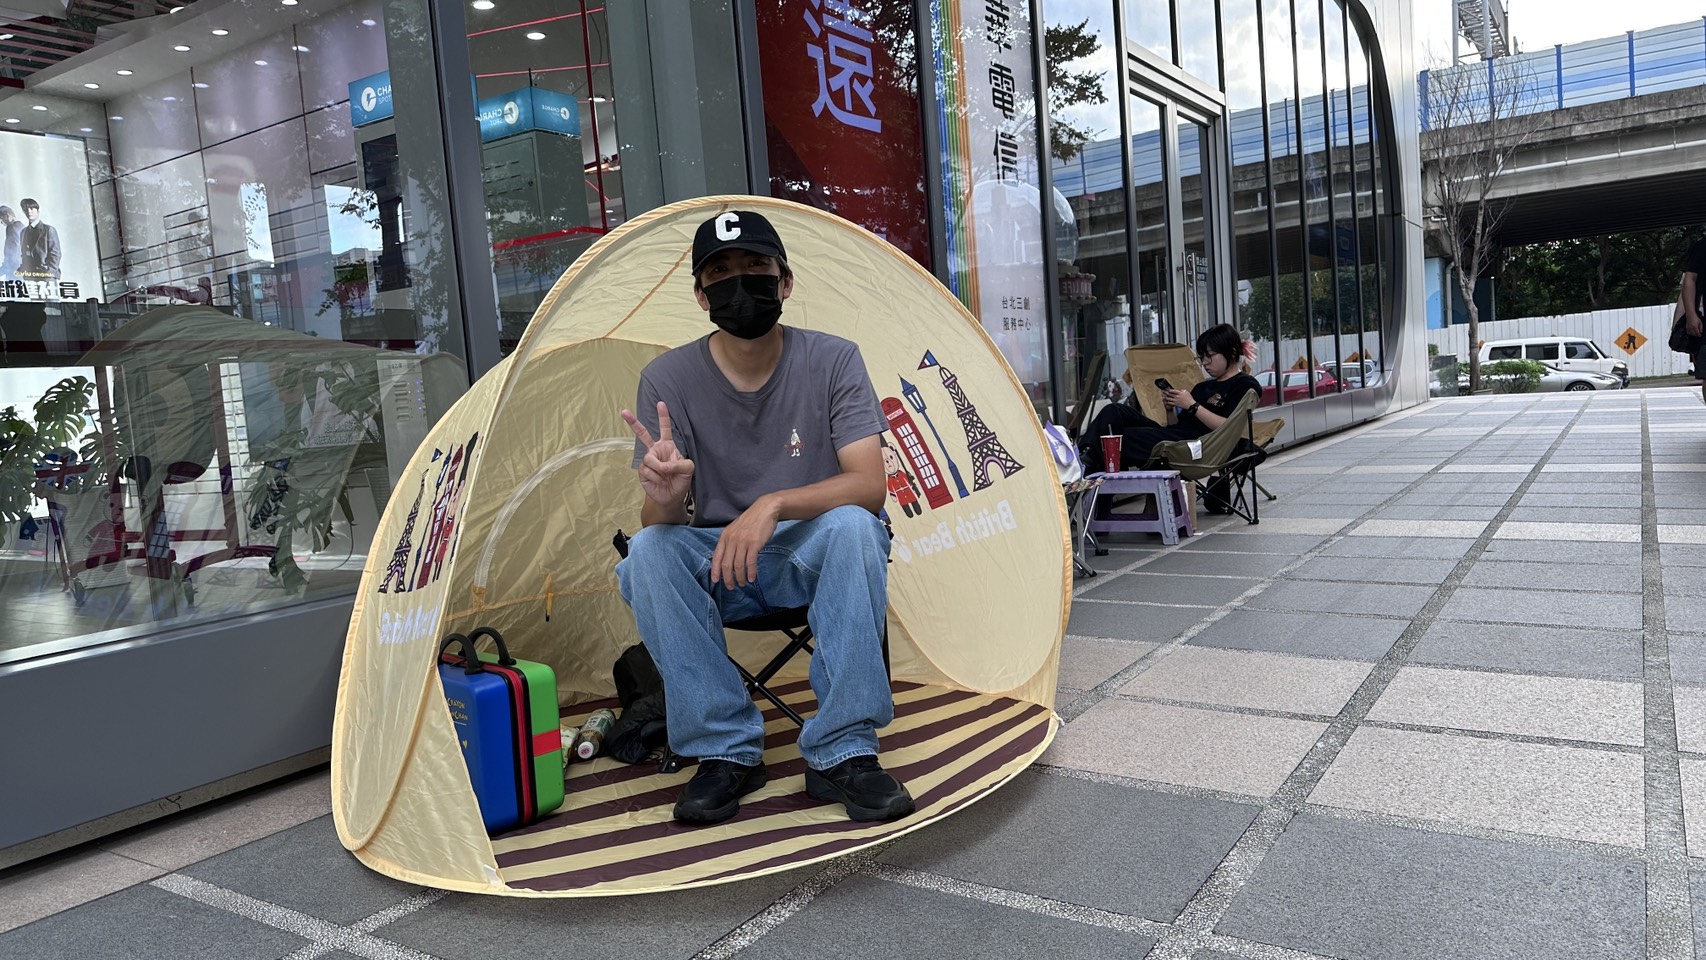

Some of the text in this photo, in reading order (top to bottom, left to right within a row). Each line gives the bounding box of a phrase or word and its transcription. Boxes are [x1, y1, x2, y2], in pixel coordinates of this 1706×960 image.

[803, 0, 881, 133] 遠
[715, 212, 741, 241] C
[1003, 317, 1031, 331] 服務中心
